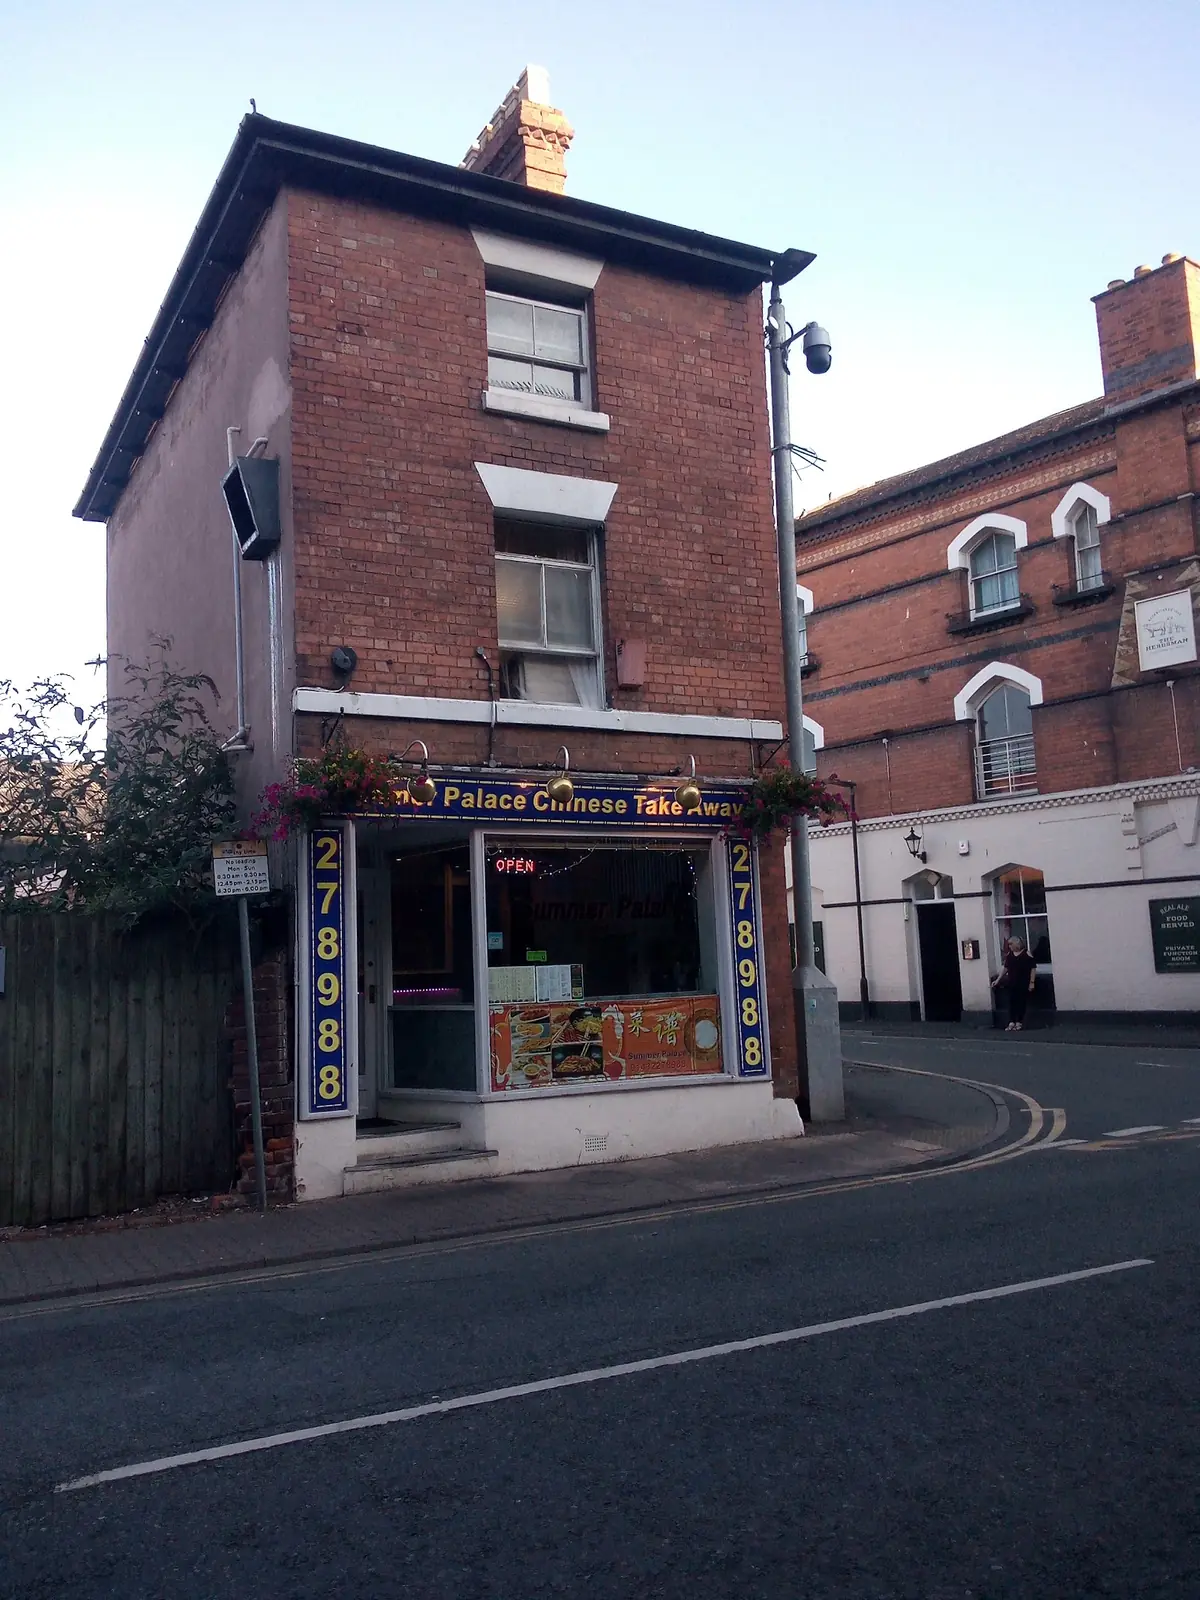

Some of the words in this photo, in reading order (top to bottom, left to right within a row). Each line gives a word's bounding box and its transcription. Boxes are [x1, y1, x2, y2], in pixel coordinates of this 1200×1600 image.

[1145, 638, 1188, 652] HERDSMAN
[444, 786, 526, 811] Palace
[633, 794, 683, 816] Take
[496, 859, 534, 872] OPEN
[1160, 903, 1176, 915] REAL
[1176, 903, 1190, 912] ALE
[1161, 921, 1195, 929] SERVED
[732, 844, 762, 1066] 278988
[315, 836, 341, 1100] 278988
[628, 1052, 660, 1060] Summer
